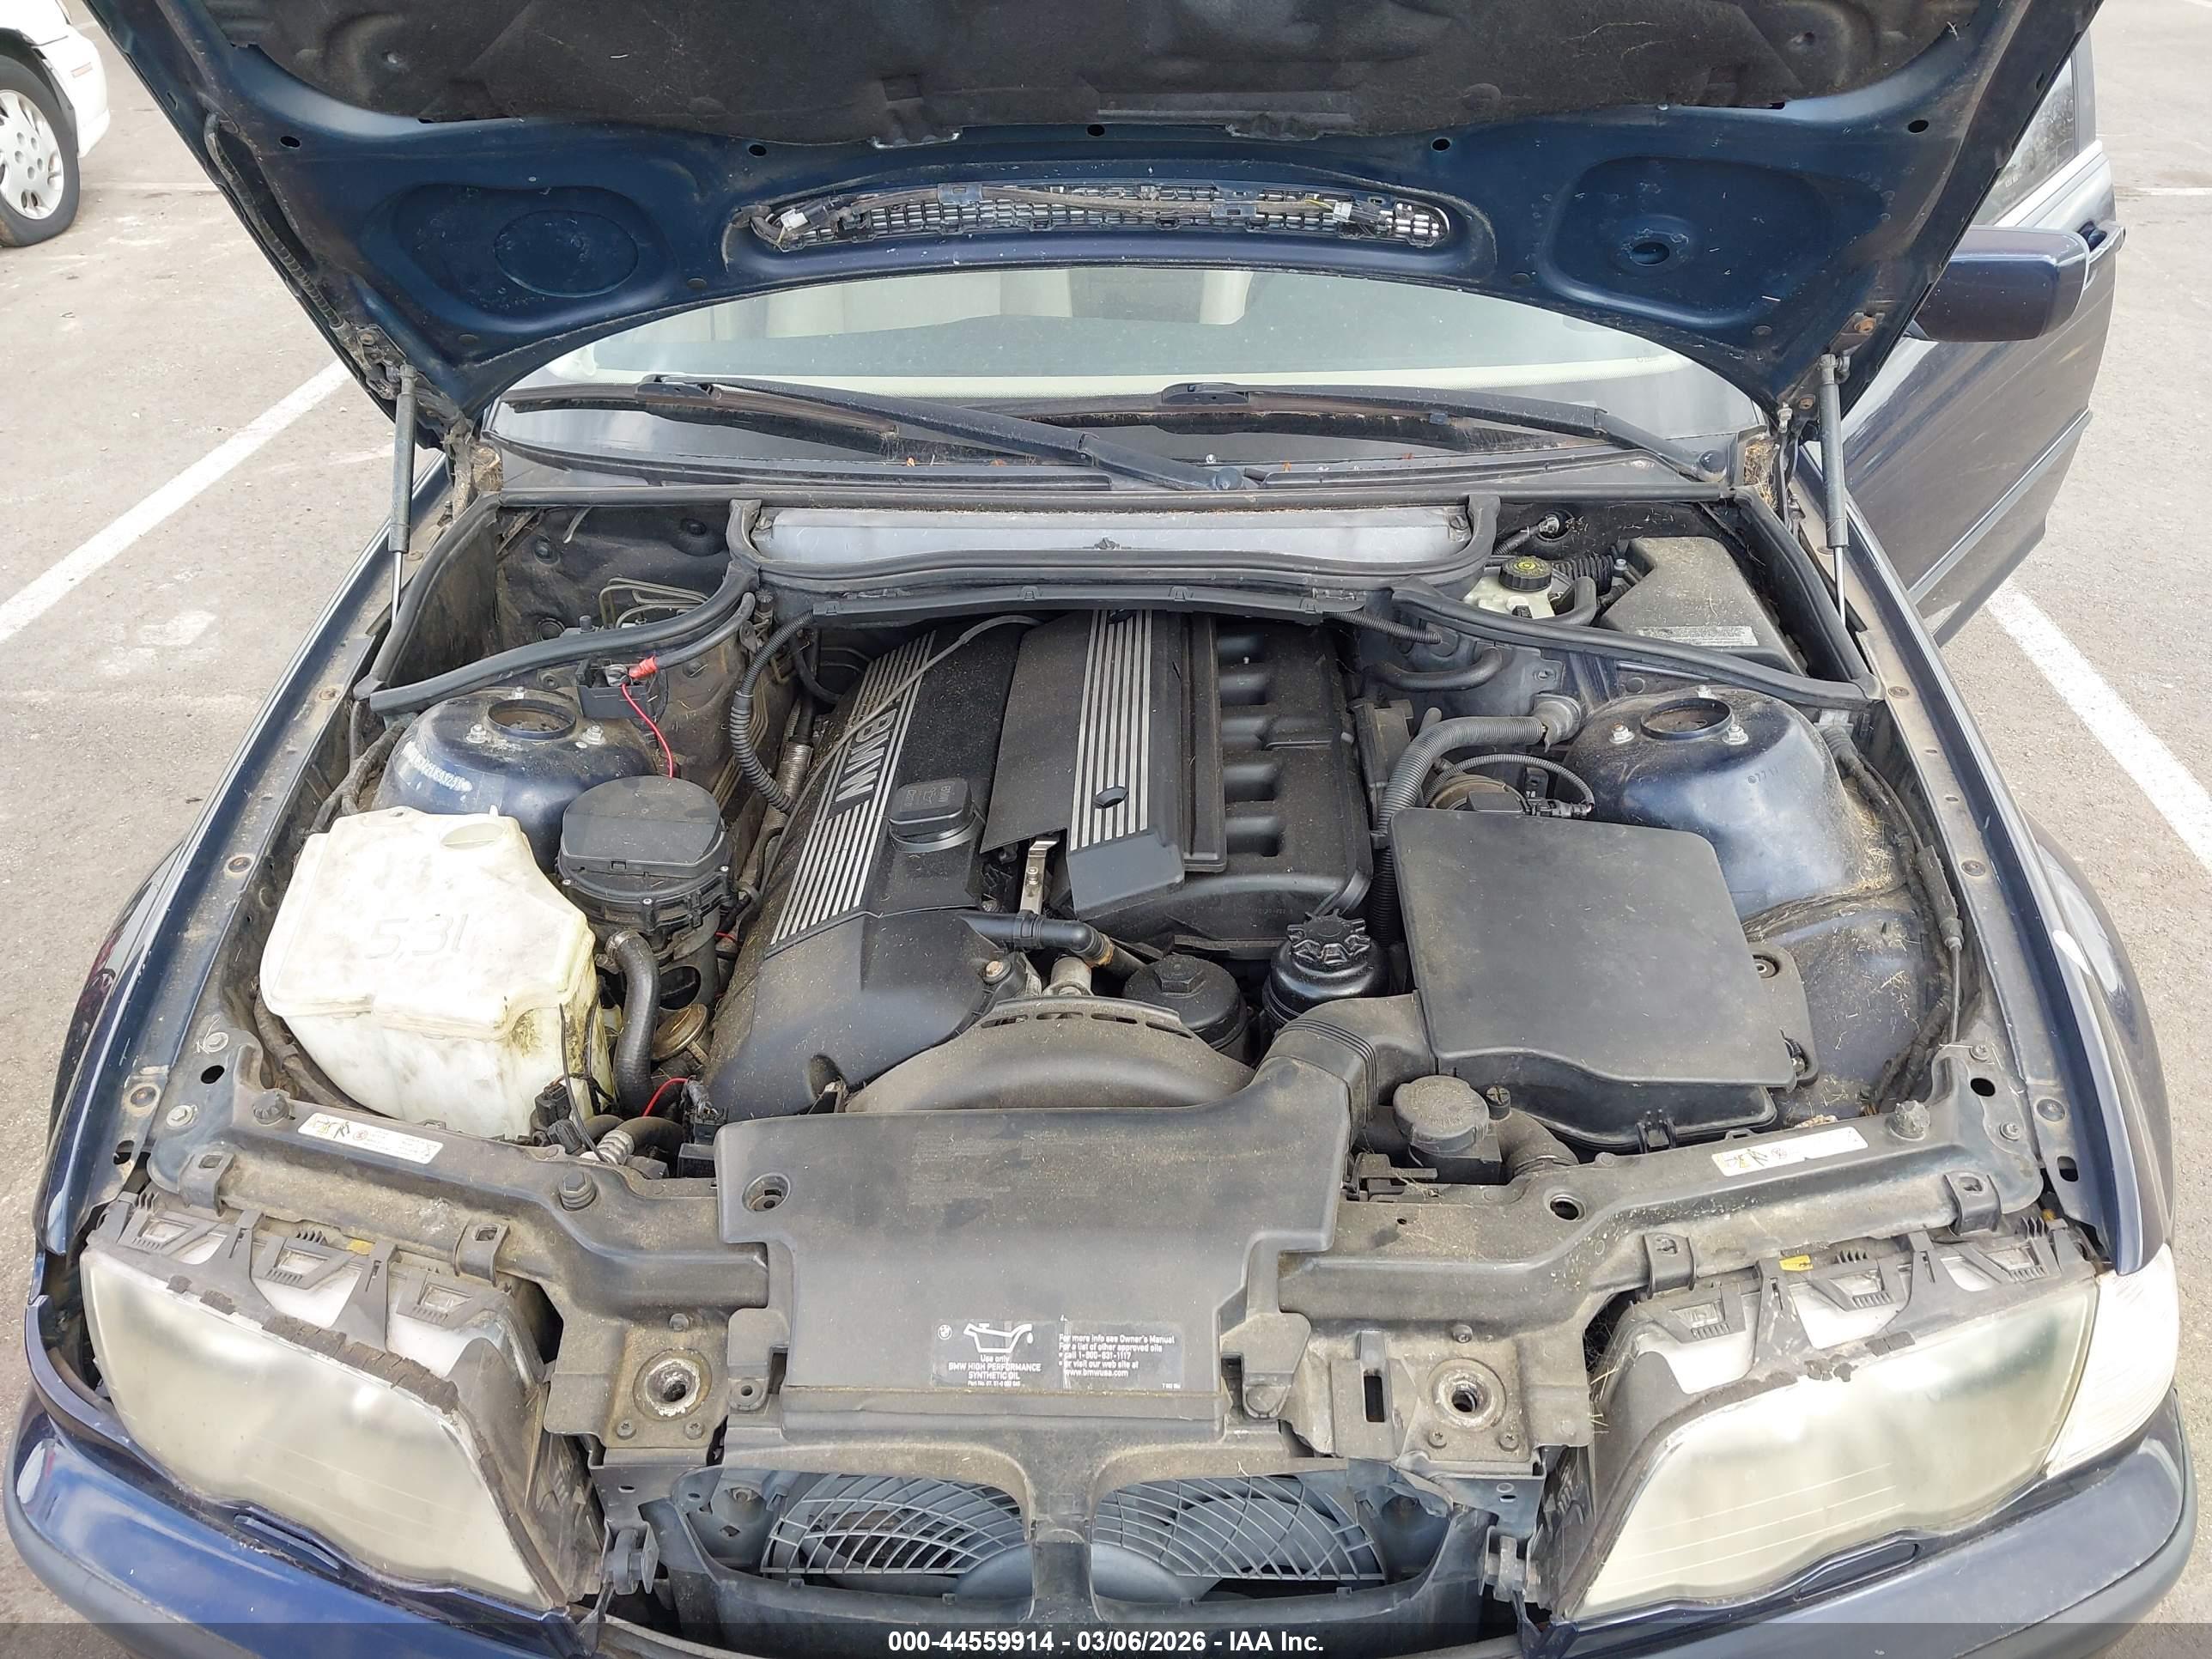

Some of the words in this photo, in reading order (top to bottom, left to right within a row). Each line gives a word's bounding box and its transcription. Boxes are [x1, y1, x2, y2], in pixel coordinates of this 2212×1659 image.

[835, 708, 898, 802] BMW
[1120, 1334, 1147, 1343] Owner's
[1150, 1335, 1175, 1344] Manual
[1117, 1344, 1149, 1352] approved
[995, 1355, 1010, 1364] only
[988, 1363, 1042, 1372] PERFORMANCE
[1102, 1360, 1116, 1369] web
[1118, 1360, 1130, 1369] site
